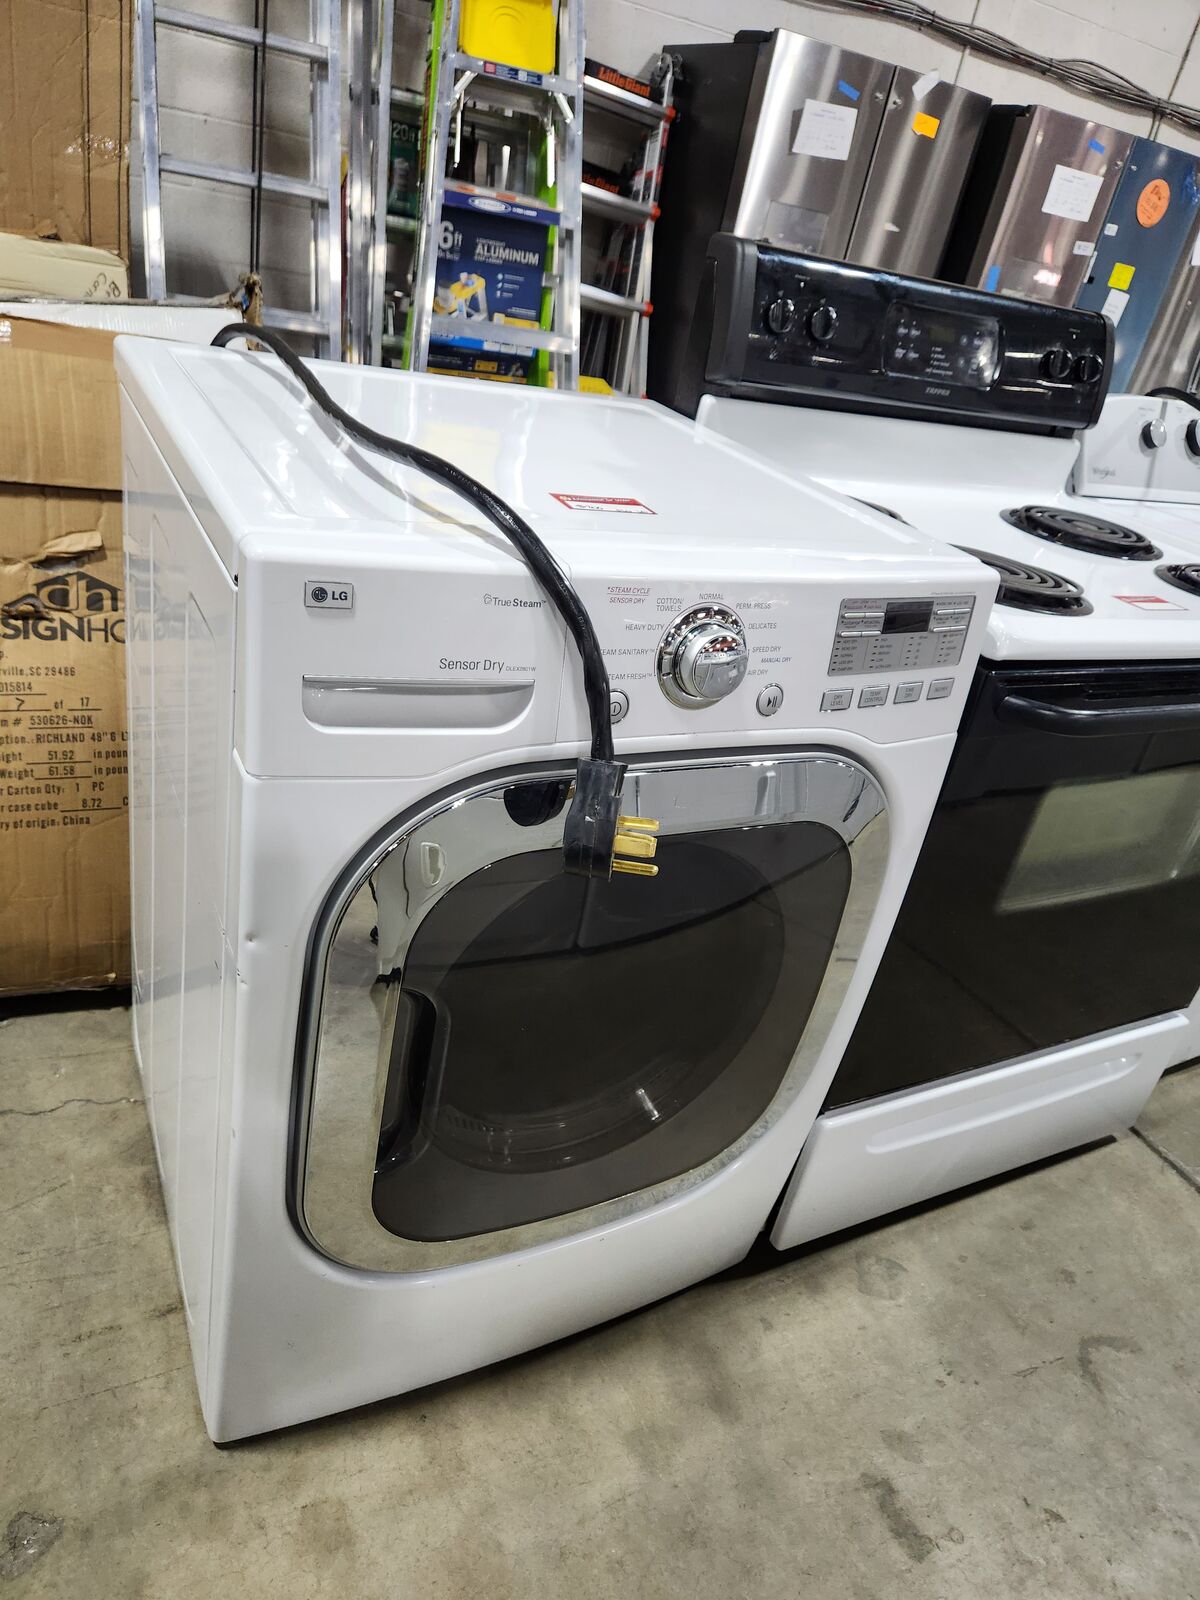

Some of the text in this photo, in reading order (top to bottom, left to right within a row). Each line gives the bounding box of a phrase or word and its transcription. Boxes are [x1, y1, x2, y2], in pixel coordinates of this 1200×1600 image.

[475, 243, 539, 267] ALUMINUM
[332, 590, 348, 601] LG
[632, 587, 651, 595] CYCLE
[754, 602, 772, 610] PRESS
[625, 623, 666, 631] HEAVY DUTY
[748, 622, 777, 630] DELICATES
[439, 658, 481, 671] Sensor
[483, 659, 505, 674] Dry
[54, 699, 64, 710] of
[80, 697, 90, 707] 17
[36, 732, 85, 744] RICHLAND
[48, 750, 75, 761] 51.92
[48, 765, 75, 776] 61.58
[7, 785, 42, 797] Carton
[75, 782, 80, 792] 1
[92, 781, 105, 792] PC
[8, 803, 32, 813] case
[34, 800, 59, 812] cube
[82, 798, 102, 809] 8.72
[13, 819, 23, 829] of
[62, 815, 91, 826] China
